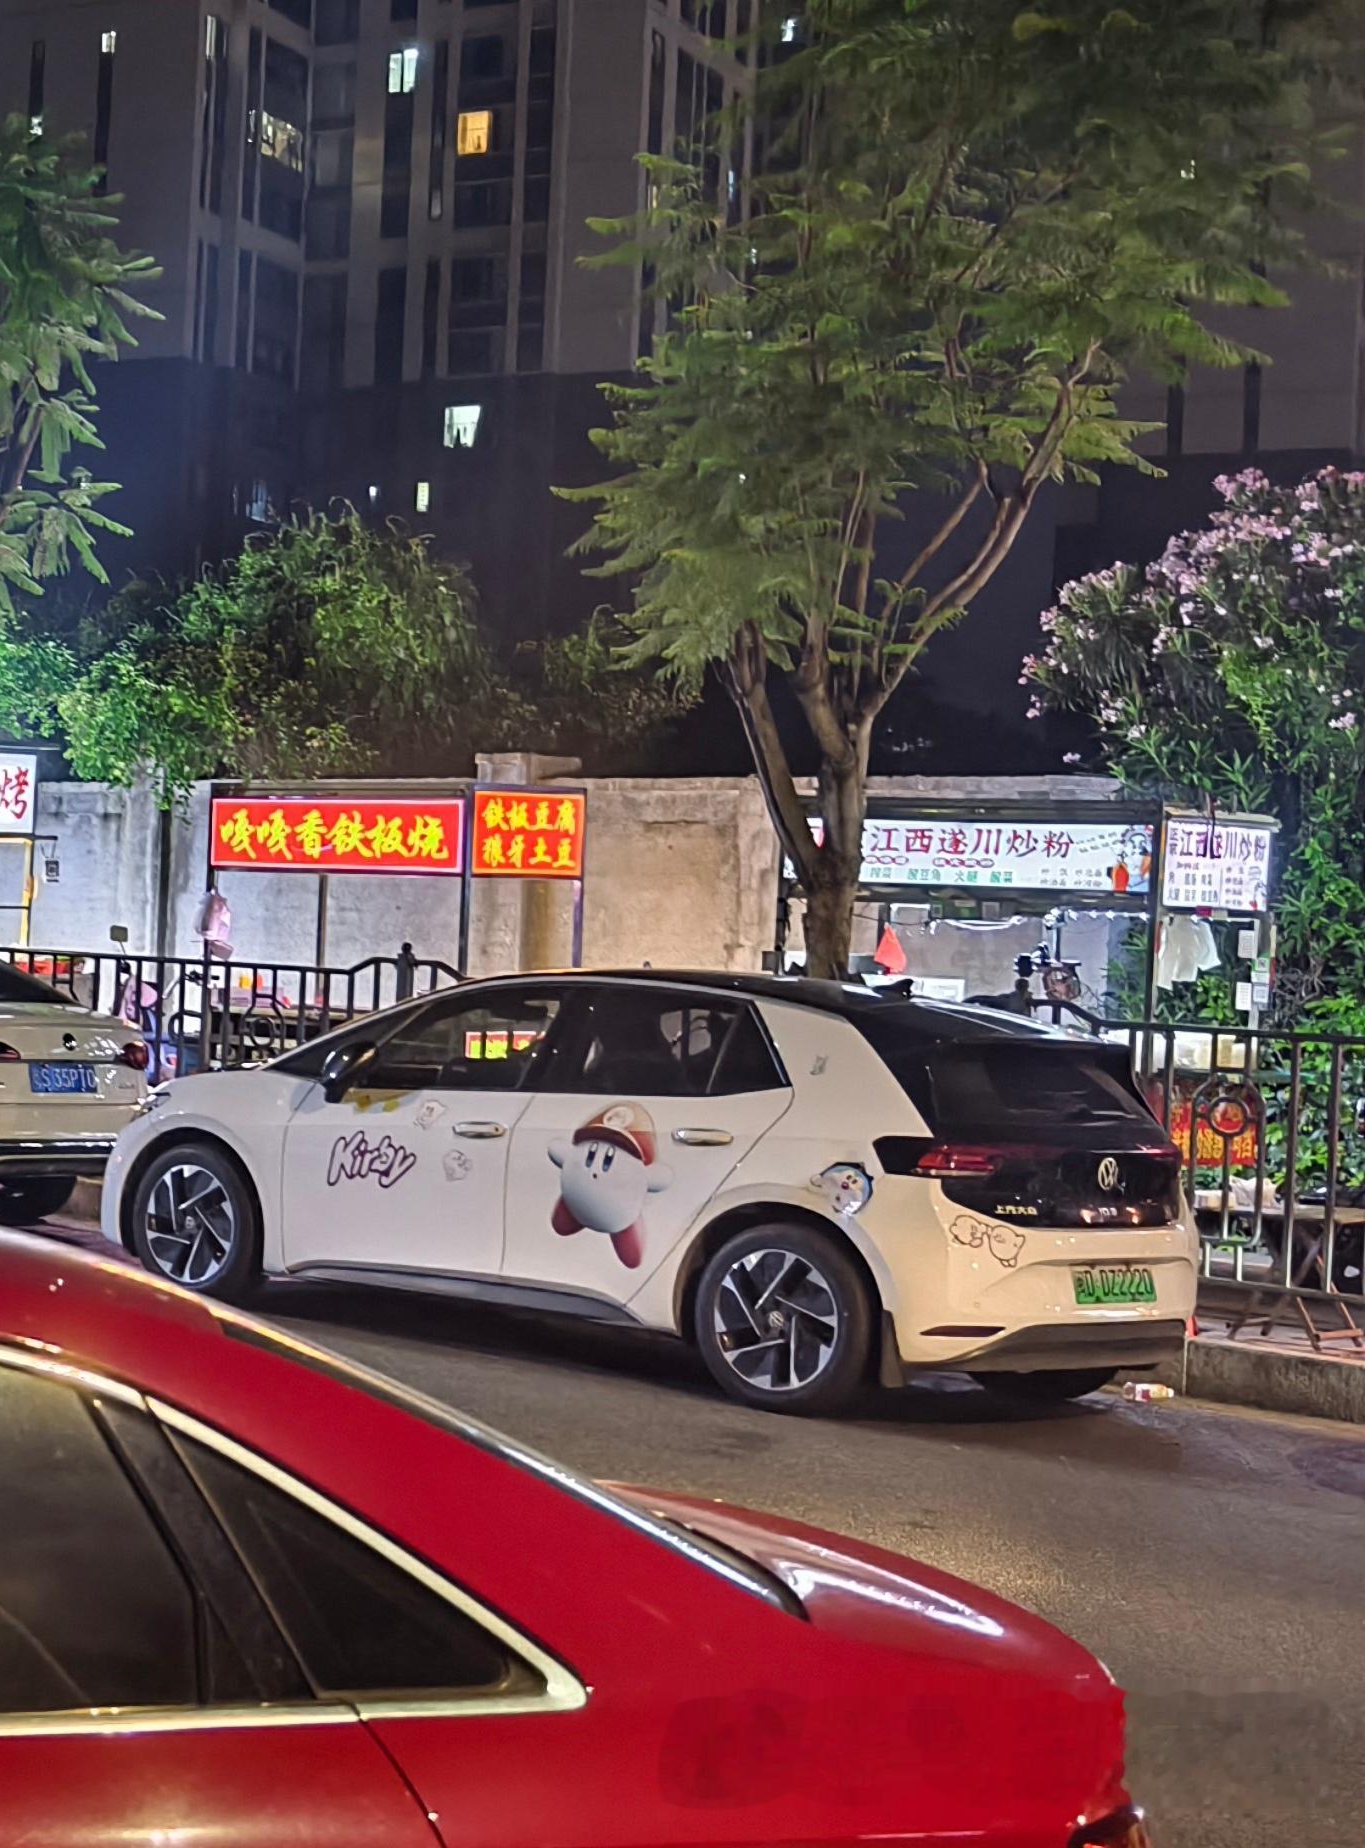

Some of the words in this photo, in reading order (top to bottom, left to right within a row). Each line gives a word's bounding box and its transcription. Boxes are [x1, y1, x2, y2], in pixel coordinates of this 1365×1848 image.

[481, 797, 576, 834] 铁板豆腐
[481, 834, 576, 869] 狼牙土豆
[870, 825, 1075, 858] 江西遂川炒粉
[327, 1130, 417, 1188] Kirby
